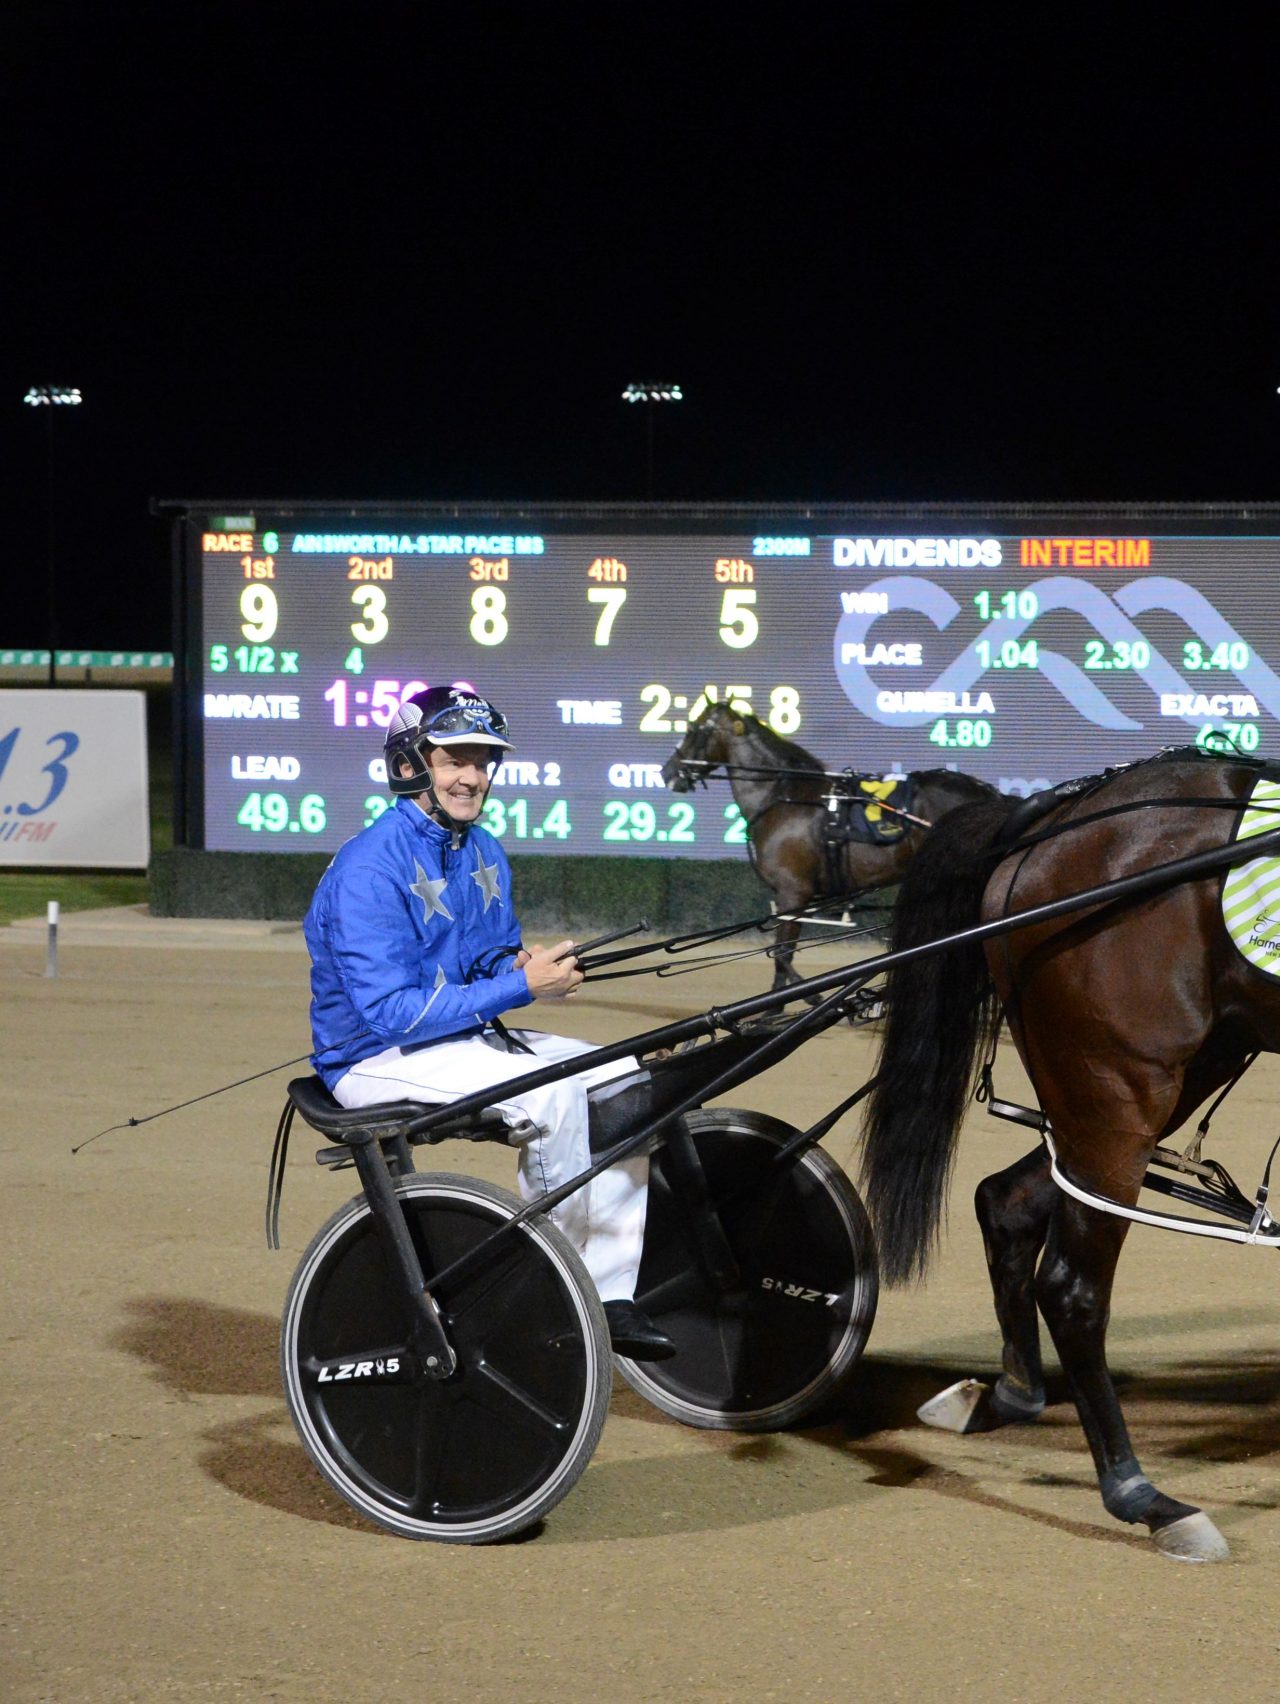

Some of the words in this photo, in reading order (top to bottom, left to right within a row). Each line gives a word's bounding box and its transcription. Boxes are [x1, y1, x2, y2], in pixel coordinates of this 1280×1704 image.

[202, 533, 254, 552] RACE
[263, 532, 279, 553] 6
[291, 534, 399, 553] AINSWORTH
[464, 536, 514, 554] PACE
[833, 538, 1002, 567] DIVIDENDS
[1020, 538, 1150, 567] INTERIM
[240, 555, 276, 579] 1st
[347, 556, 393, 580] 2nd
[468, 557, 509, 581] 3rd
[587, 558, 627, 582] 4th
[714, 559, 754, 583] 5th
[239, 583, 279, 643] 9
[350, 584, 389, 645] 3
[469, 585, 509, 646] 8
[587, 587, 627, 646] 7
[719, 588, 759, 649] 5
[840, 592, 889, 615] WIN
[974, 590, 1039, 620] 1.10
[210, 645, 229, 673] 5
[234, 646, 275, 673] 1/2
[345, 647, 364, 674] 4
[841, 643, 923, 666] PLACE
[974, 639, 1039, 669] 1.04
[1084, 640, 1150, 671] 2.30
[1183, 641, 1250, 671] 3.40
[556, 699, 622, 725] TIME
[1160, 694, 1260, 717] EXACTA
[929, 718, 992, 748] 4.80
[231, 755, 301, 780] LEAD
[543, 762, 561, 786] 2
[237, 793, 327, 833] 49.6
[481, 798, 572, 840] 31.4
[602, 800, 696, 842] 29.2
[317, 1361, 375, 1383] LZR
